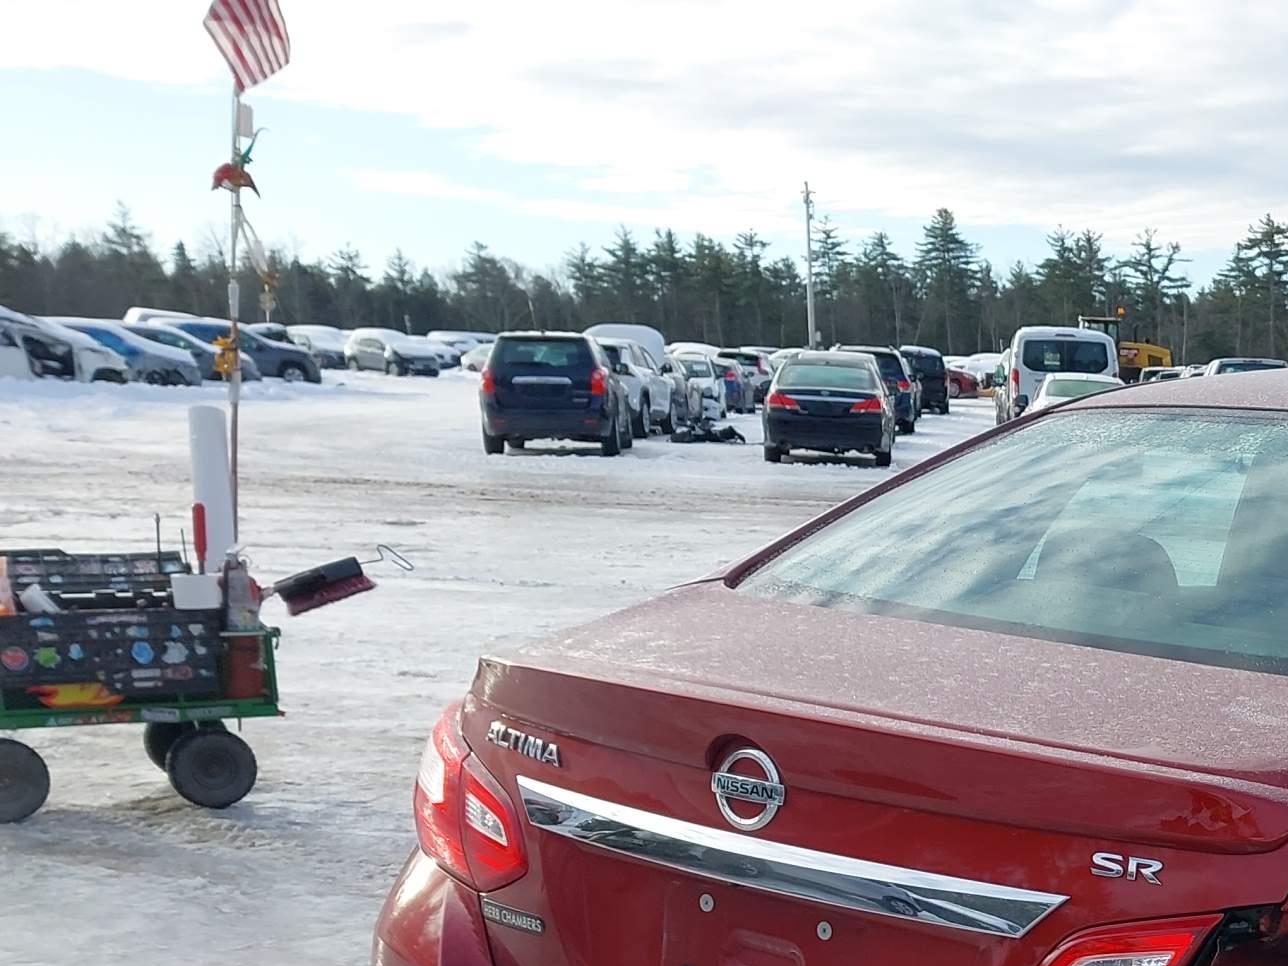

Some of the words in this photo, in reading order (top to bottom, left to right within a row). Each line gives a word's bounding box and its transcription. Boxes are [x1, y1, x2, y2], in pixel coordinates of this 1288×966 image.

[486, 720, 562, 768] ALTIMA
[716, 776, 775, 800] NISSAN
[1090, 851, 1165, 886] SR
[501, 910, 542, 932] CHAMBERS
